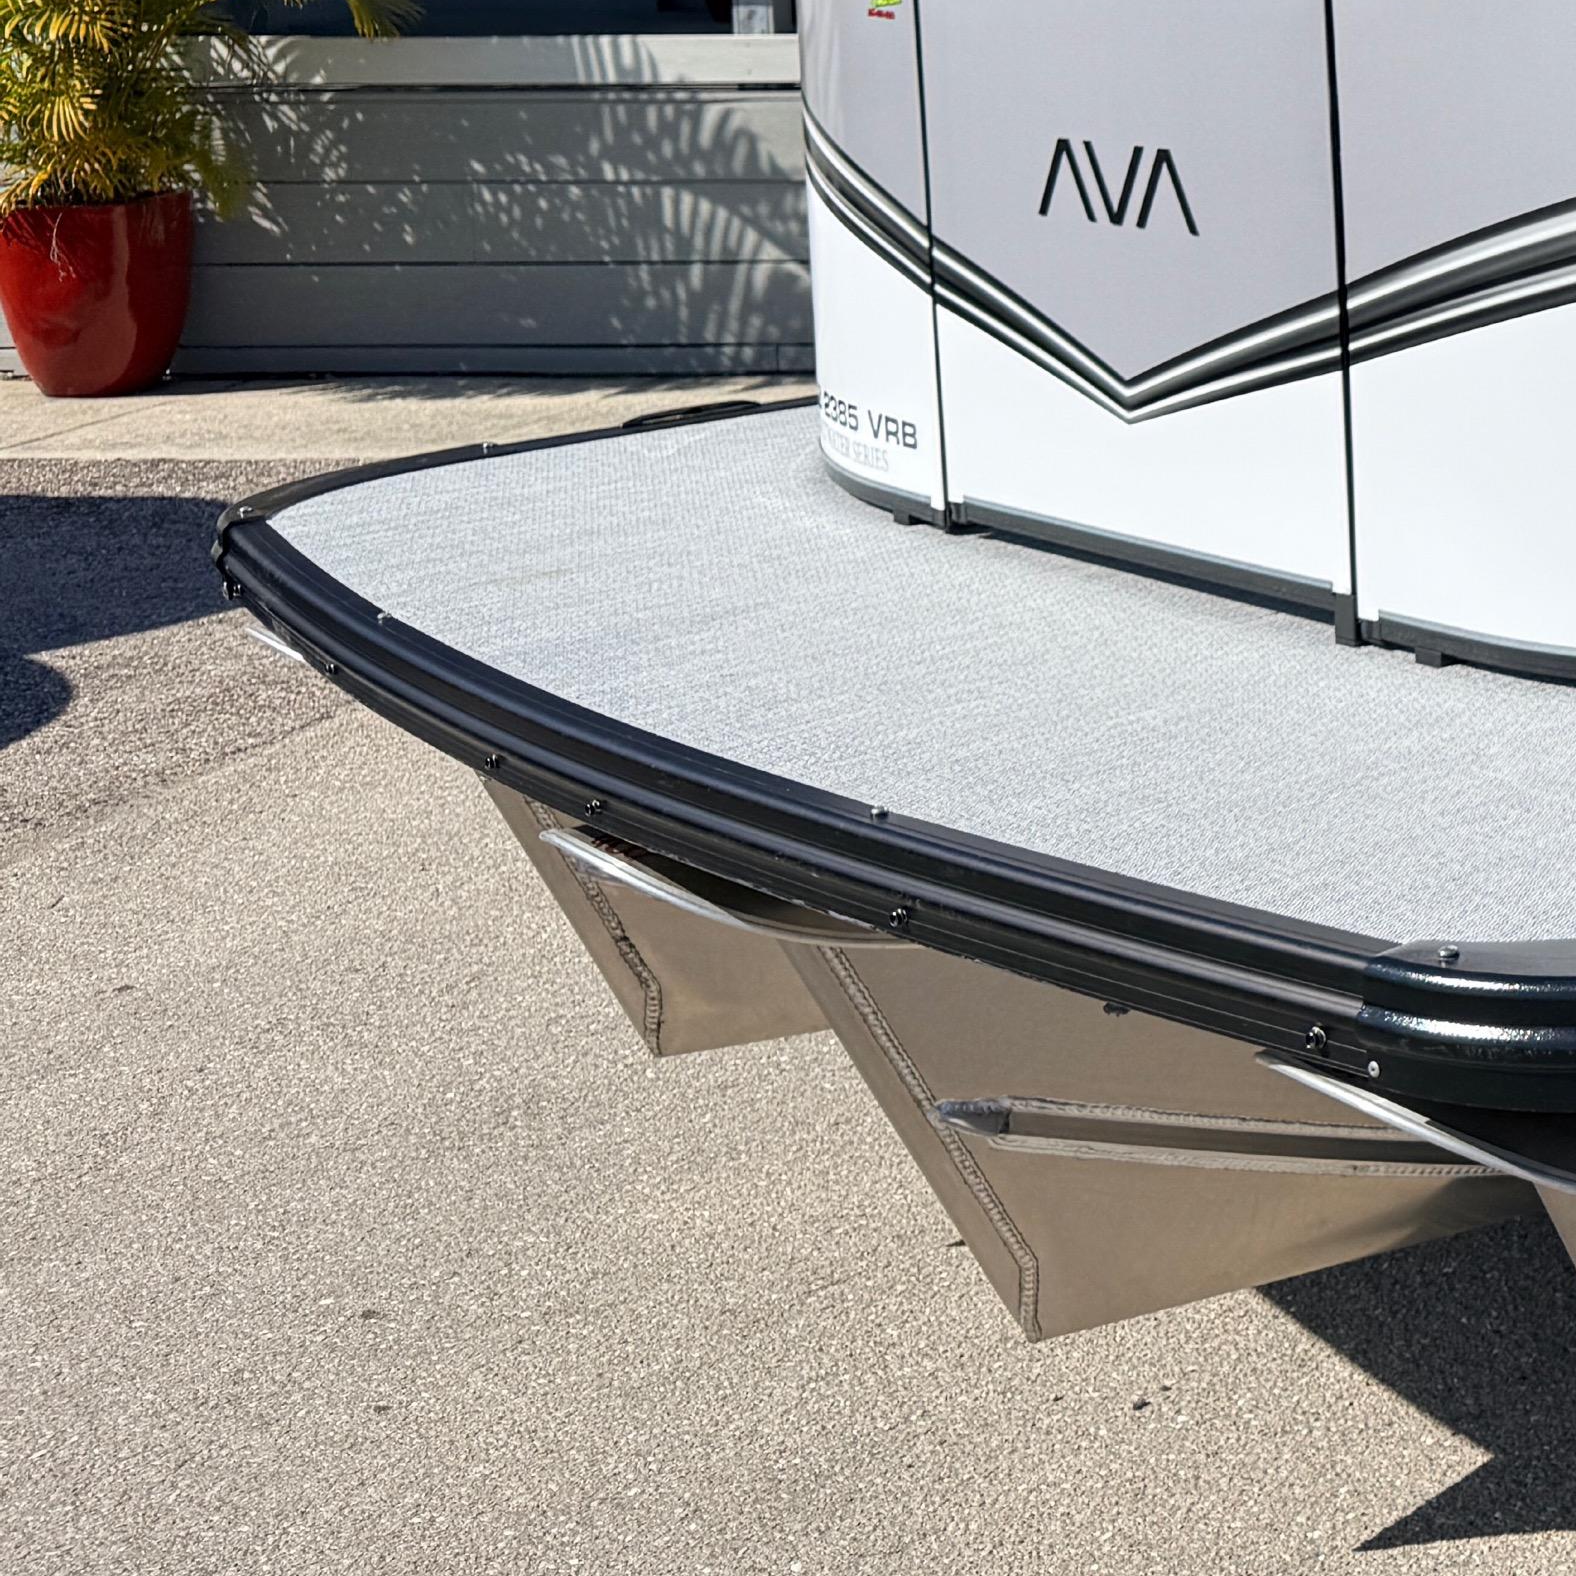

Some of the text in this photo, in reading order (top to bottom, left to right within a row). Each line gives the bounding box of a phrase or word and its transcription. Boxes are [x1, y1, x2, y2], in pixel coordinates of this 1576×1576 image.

[1039, 137, 1200, 237] AVA
[823, 390, 918, 450] 2385 VRB
